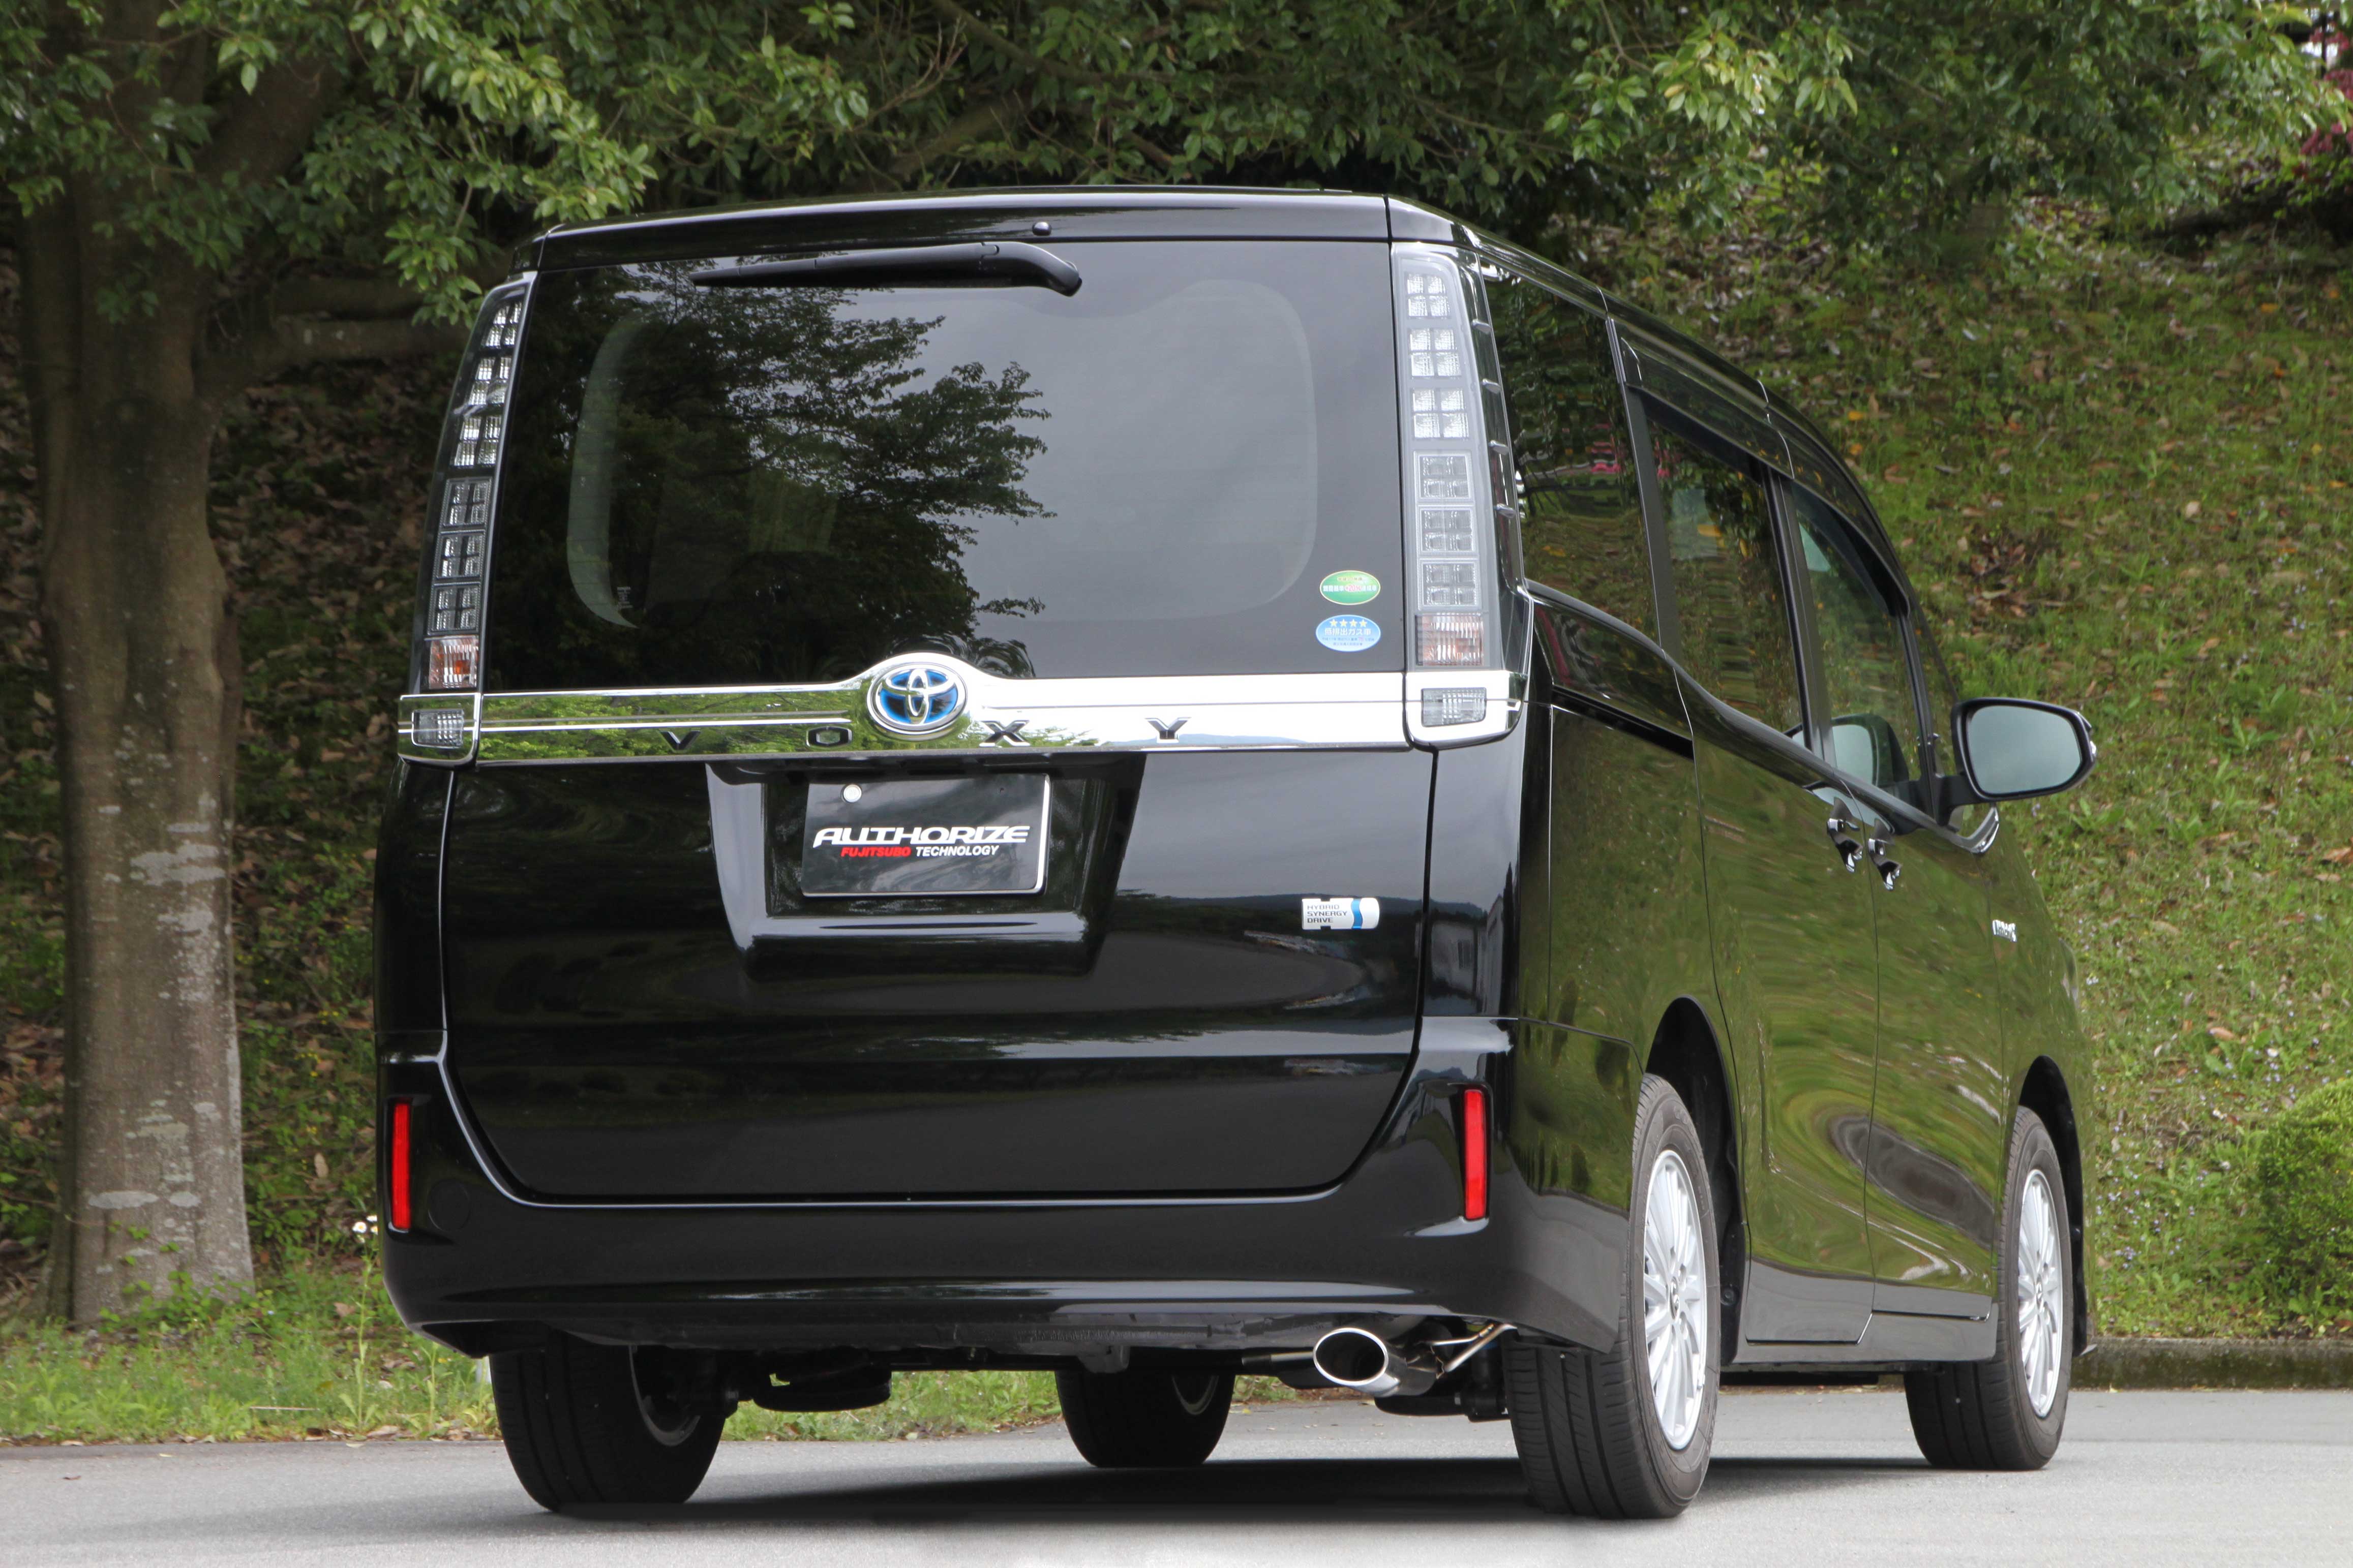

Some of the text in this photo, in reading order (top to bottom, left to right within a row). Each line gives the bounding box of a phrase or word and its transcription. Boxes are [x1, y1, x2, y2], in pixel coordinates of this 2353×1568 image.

[813, 825, 1030, 848] AUTHORIZE
[840, 845, 1000, 857] FUJITSUBO TECHNOLOGY
